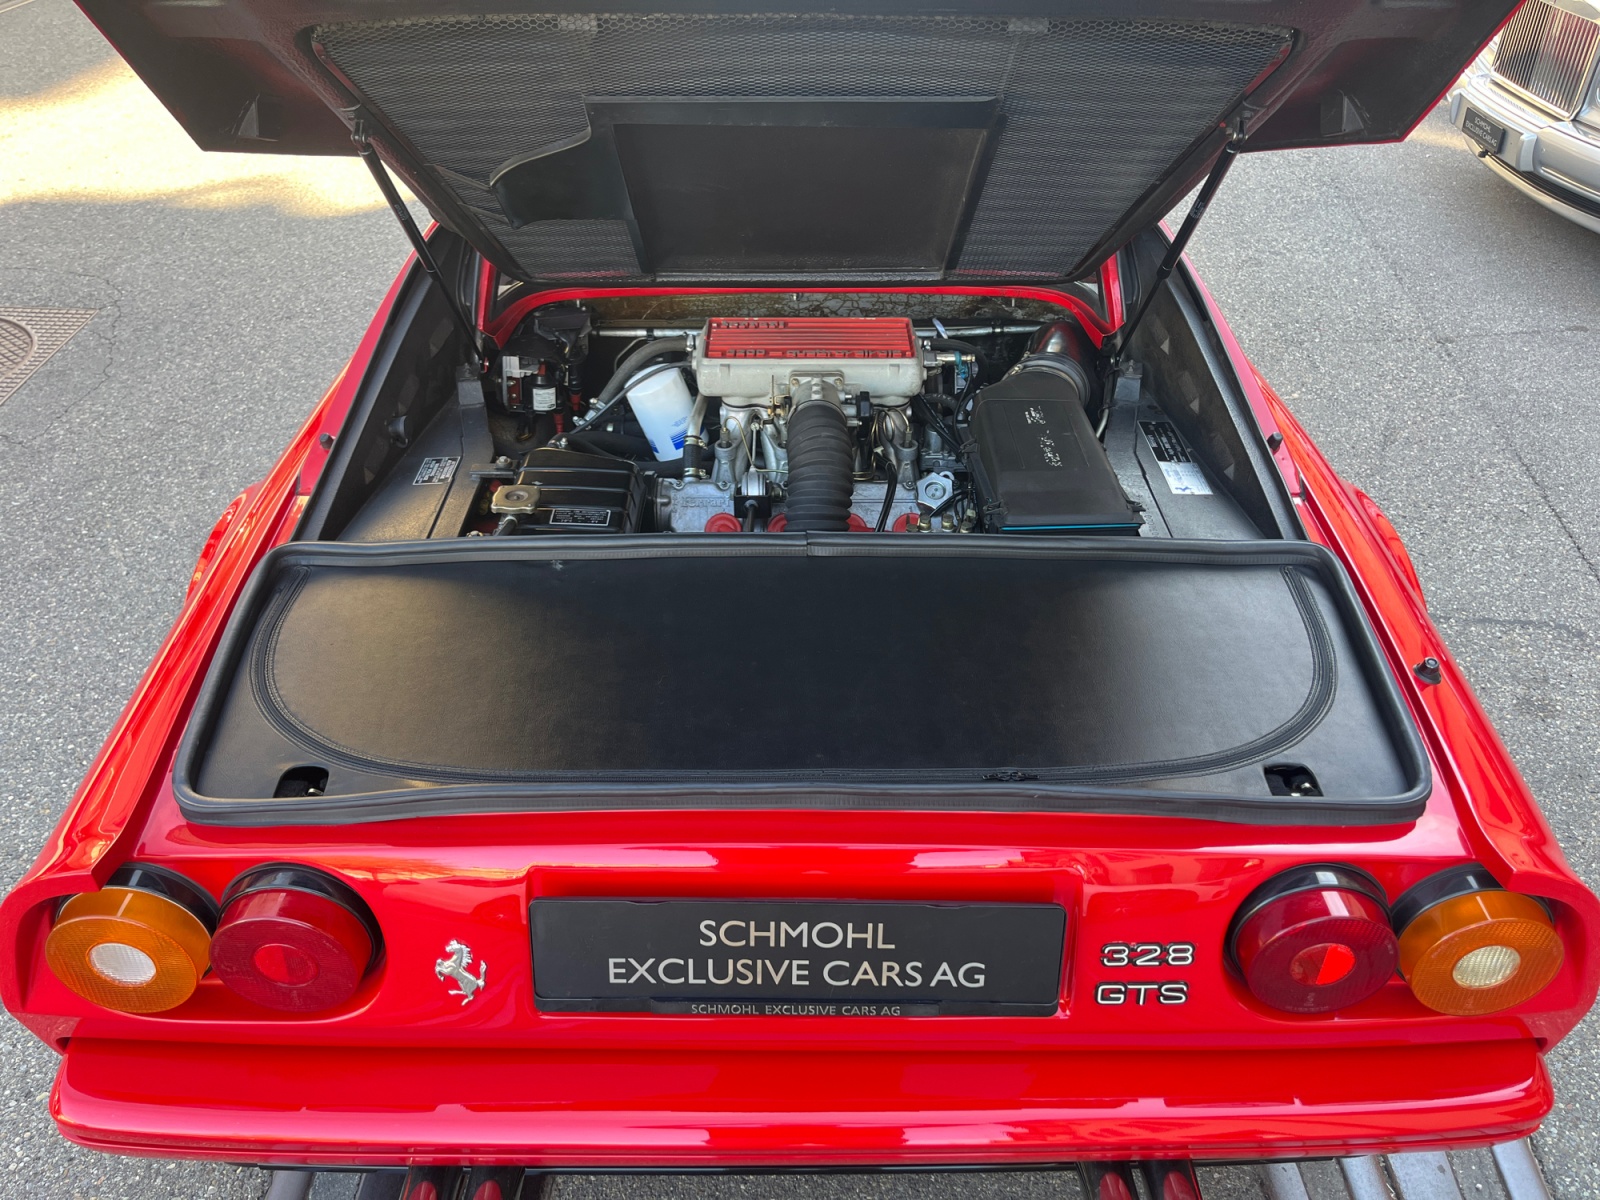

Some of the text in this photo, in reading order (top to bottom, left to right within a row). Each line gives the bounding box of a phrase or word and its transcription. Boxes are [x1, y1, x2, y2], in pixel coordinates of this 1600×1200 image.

[699, 919, 896, 950] SCHMOHL
[1102, 942, 1195, 967] 328
[607, 957, 986, 988] EXCLUSIVE CARS AG
[1096, 982, 1188, 1005] GTS
[690, 1004, 901, 1016] SCHMOHL EXCLUSIVE CARS AG
